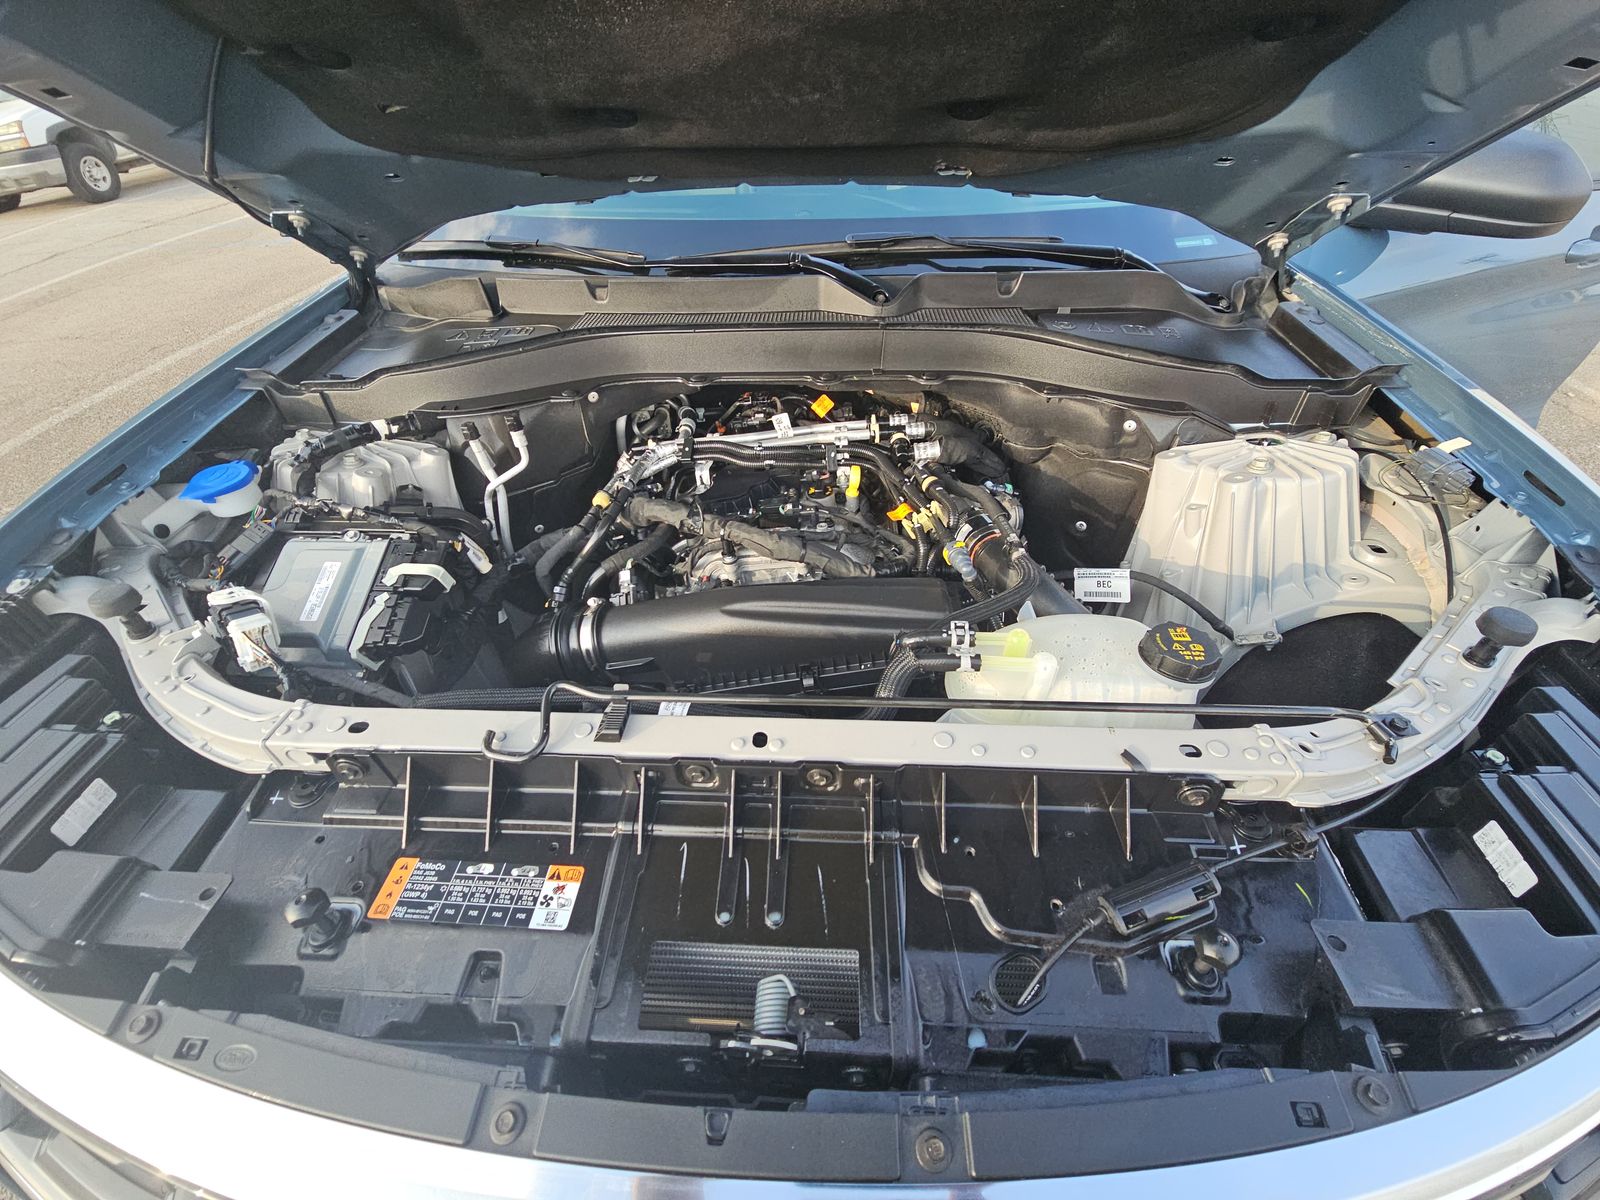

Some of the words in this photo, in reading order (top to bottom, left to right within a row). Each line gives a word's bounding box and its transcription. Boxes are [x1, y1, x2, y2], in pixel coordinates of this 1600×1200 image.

[1096, 580, 1112, 588] BEC
[415, 861, 446, 871] FoMoCo
[405, 883, 435, 892] R-1234yf
